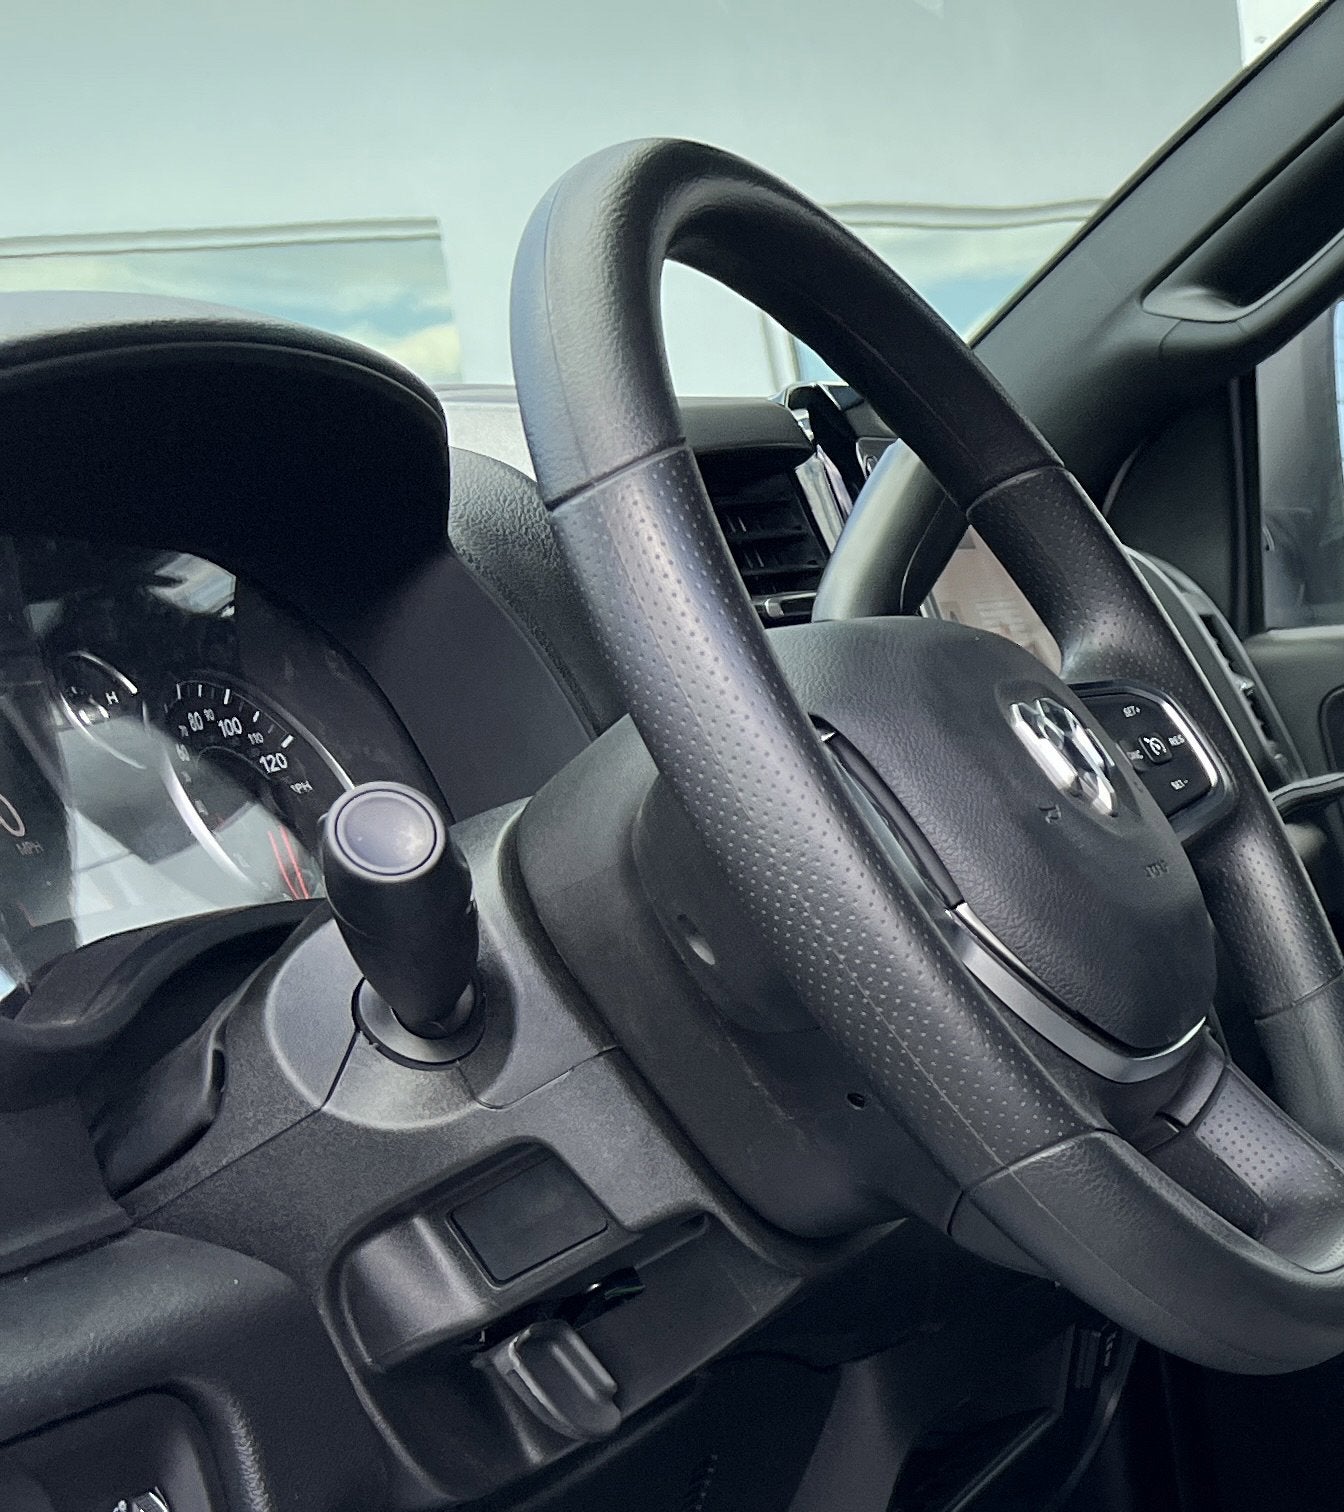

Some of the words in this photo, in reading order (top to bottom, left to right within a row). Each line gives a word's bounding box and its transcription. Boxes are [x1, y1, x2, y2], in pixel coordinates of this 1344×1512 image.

[217, 716, 243, 738] 100
[247, 731, 264, 745] 110
[259, 751, 288, 774] 120
